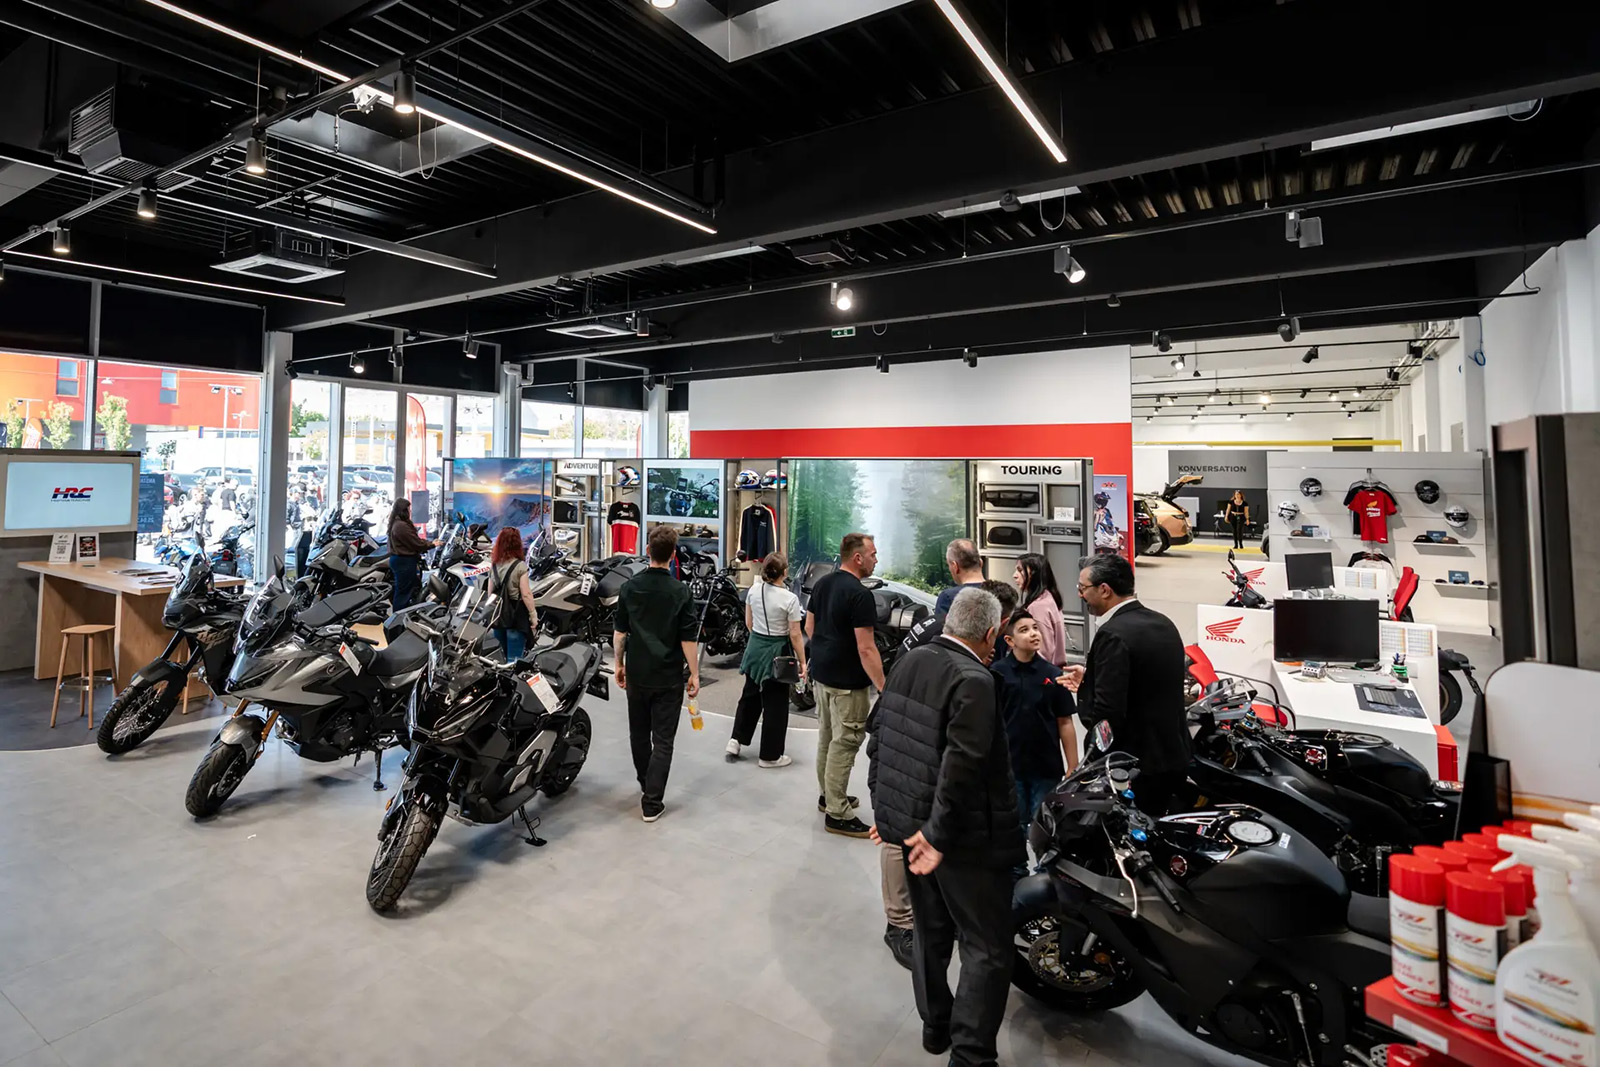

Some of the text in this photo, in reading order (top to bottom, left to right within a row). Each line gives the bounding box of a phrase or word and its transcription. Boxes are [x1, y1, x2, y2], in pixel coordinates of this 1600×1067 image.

[1001, 465, 1062, 475] TOURING
[52, 487, 93, 498] HRC
[463, 566, 491, 577] HONDA
[1206, 635, 1245, 644] HONDA
